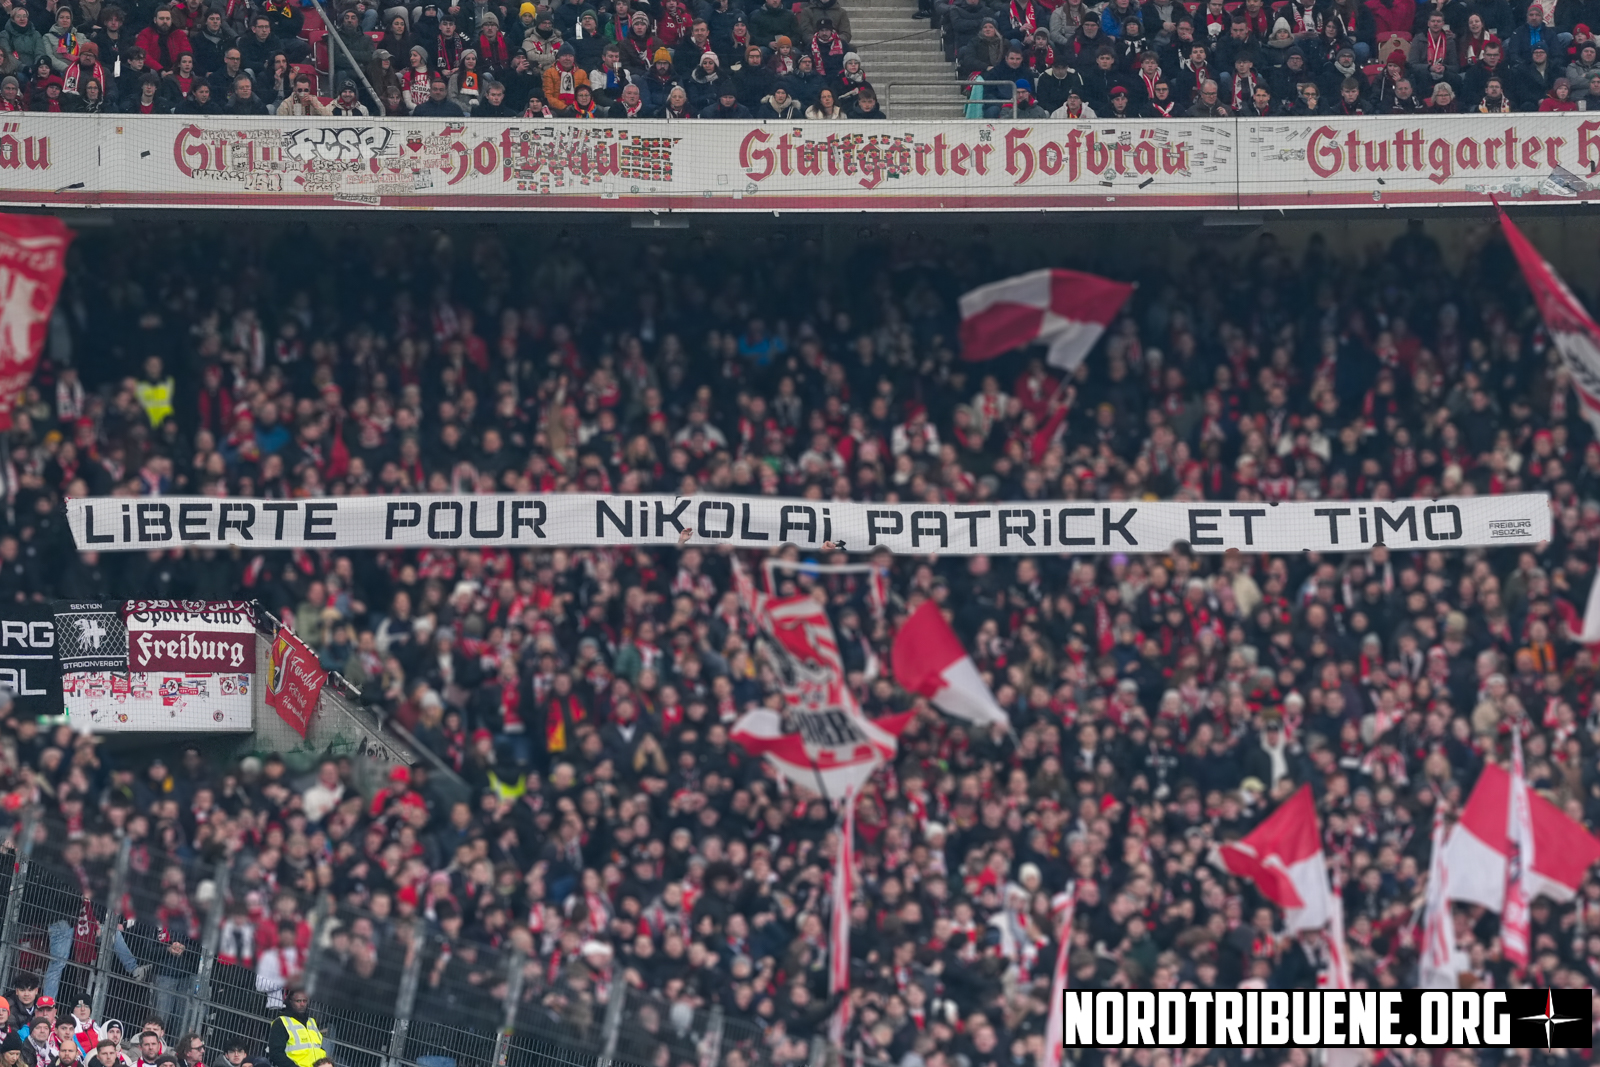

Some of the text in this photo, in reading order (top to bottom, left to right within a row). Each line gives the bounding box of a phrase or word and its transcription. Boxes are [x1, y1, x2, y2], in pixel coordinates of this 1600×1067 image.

[1005, 127, 1187, 186] Hofbräu
[1307, 125, 1565, 185] Stuttgarter
[85, 503, 338, 543] LiBERTE
[385, 500, 547, 540] POUR
[867, 508, 1138, 547] PATRiCK
[1188, 509, 1266, 545] ET
[1314, 504, 1463, 545] TiMO
[136, 632, 245, 667] Freiburg
[290, 655, 324, 692] Fanclub
